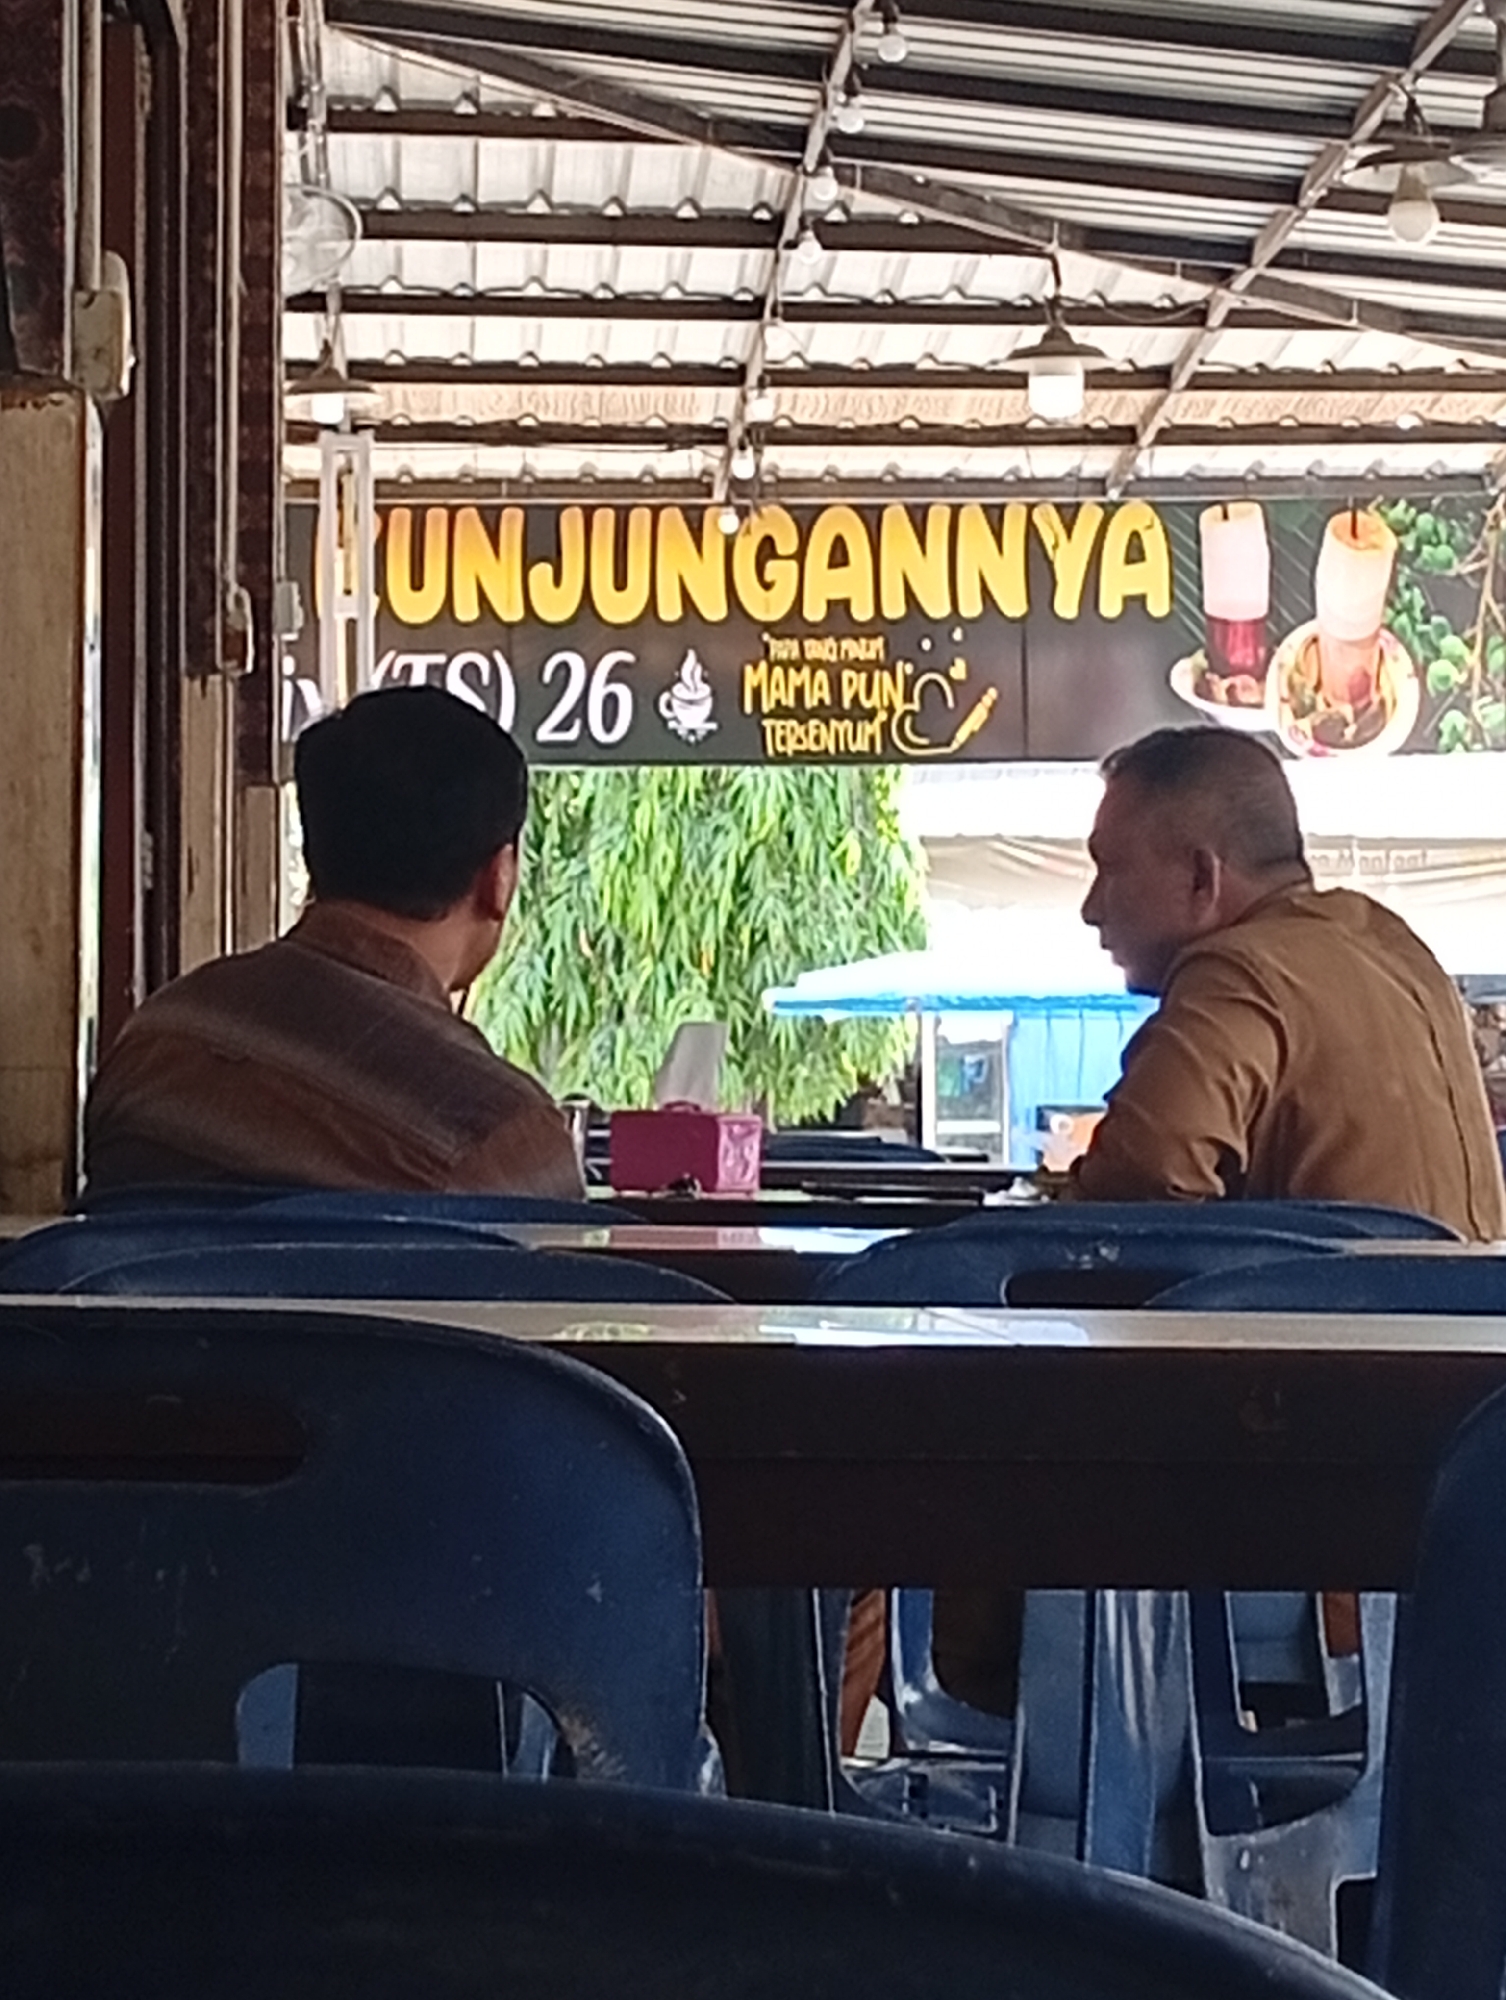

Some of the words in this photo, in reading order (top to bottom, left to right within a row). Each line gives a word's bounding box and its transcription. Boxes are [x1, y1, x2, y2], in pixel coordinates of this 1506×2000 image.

[535, 650, 637, 744] 26
[743, 659, 831, 715] MAMA
[841, 660, 905, 711] PUN
[761, 717, 883, 757] TERSENYUM
